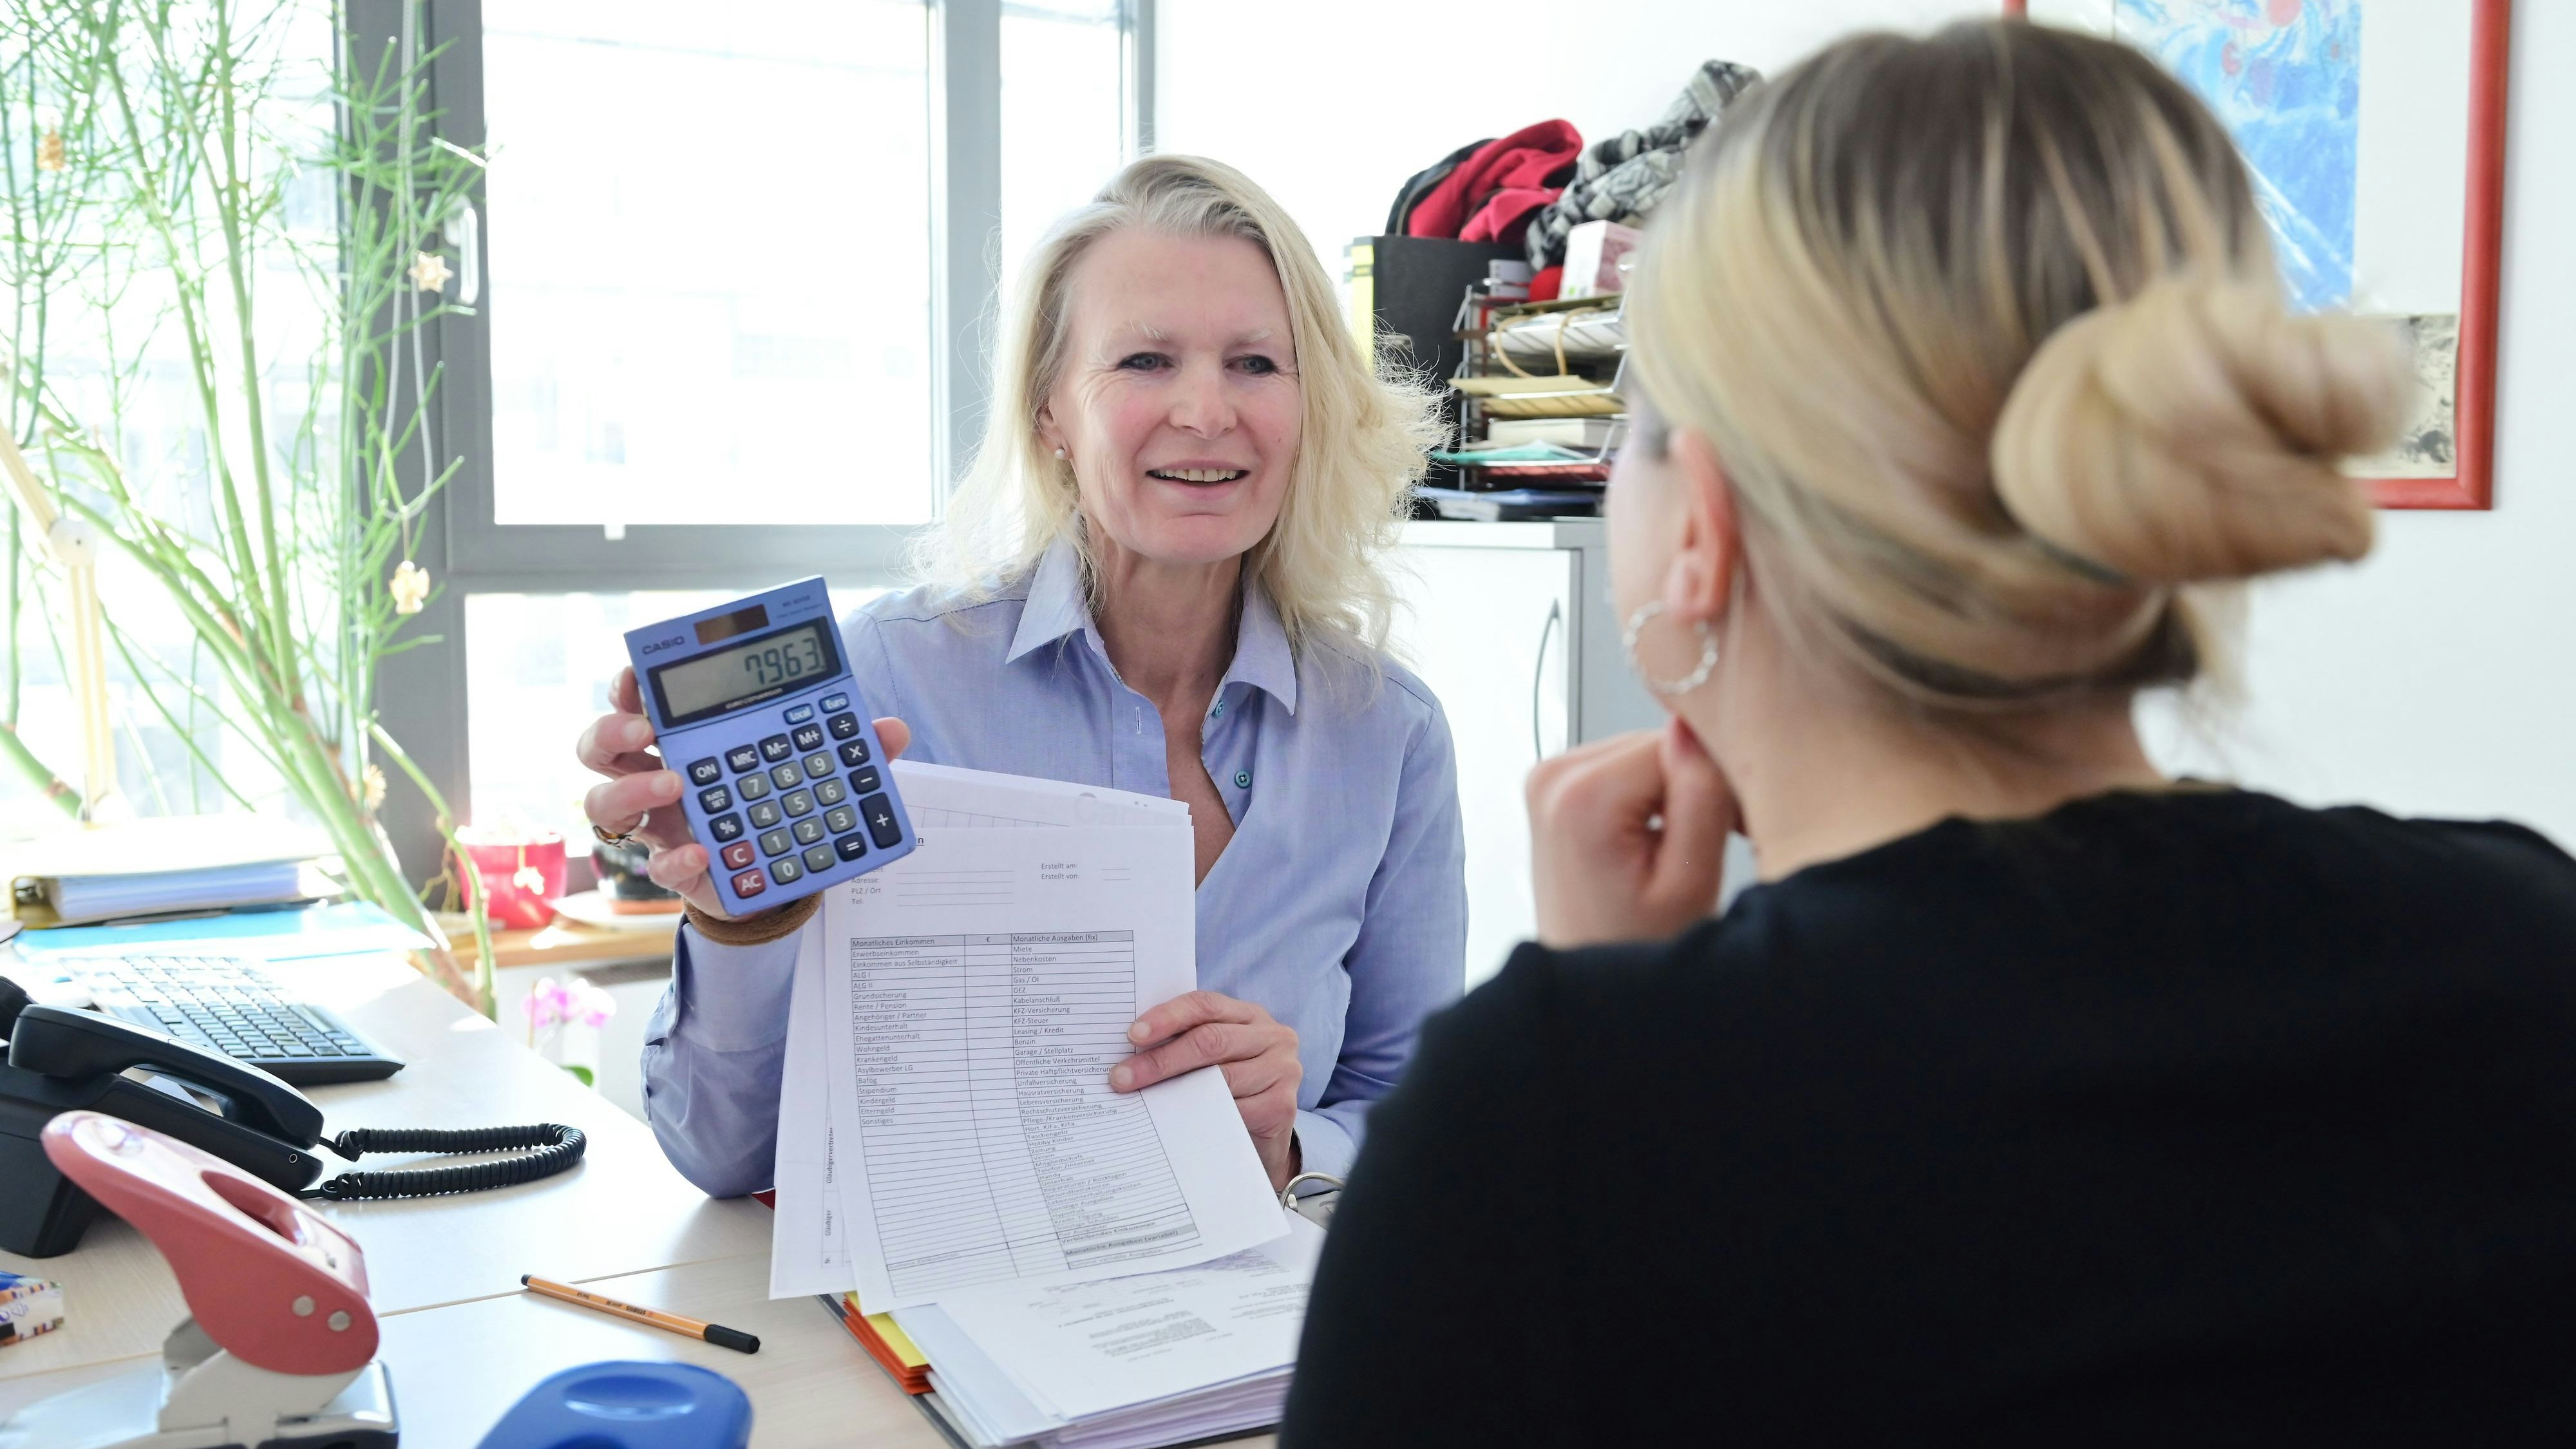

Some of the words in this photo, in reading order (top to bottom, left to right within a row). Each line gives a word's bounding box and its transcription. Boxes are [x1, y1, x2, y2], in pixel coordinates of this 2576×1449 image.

[641, 636, 685, 655] CASIO
[825, 698, 846, 709] Euro
[789, 707, 812, 721] Local
[696, 763, 717, 778] ON
[732, 750, 757, 766] MRC
[798, 730, 820, 745] M+
[748, 779, 759, 793] 7
[781, 768, 795, 782] 8
[813, 757, 826, 772] 9
[719, 820, 736, 835] %
[761, 807, 772, 820] 4
[793, 796, 806, 811] 5
[826, 784, 837, 799] 6
[733, 848, 747, 863] C
[772, 836, 782, 849] 1
[804, 823, 817, 838] 2
[835, 812, 848, 827] 3
[741, 875, 761, 891] AC
[782, 862, 794, 876] 0
[1052, 934, 1084, 943] Ausgaben
[854, 992, 907, 1000] Grundsicherung
[1014, 1007, 1070, 1015] KFZ-Versicherung
[855, 1023, 908, 1031] Kindesunterhalt
[855, 1033, 920, 1042] Ehegattenunterhalt
[856, 1045, 890, 1054] Wohngeld
[857, 1055, 898, 1063] Krankengeld
[1052, 1056, 1100, 1065] Verkehrsmittel
[857, 1066, 902, 1074] Asylbewerber
[1018, 1078, 1077, 1087] Unfallversicherung
[1018, 1088, 1084, 1096] Hausratversicherung
[860, 1097, 896, 1105] Kindergeld
[1019, 1097, 1084, 1106] Lebensversicherung
[861, 1107, 895, 1115] Elterngeld
[1021, 1103, 1102, 1115] Rechtschutzversicherung
[862, 1117, 893, 1126] Sonstiges
[1027, 1130, 1068, 1140] Taschengeld
